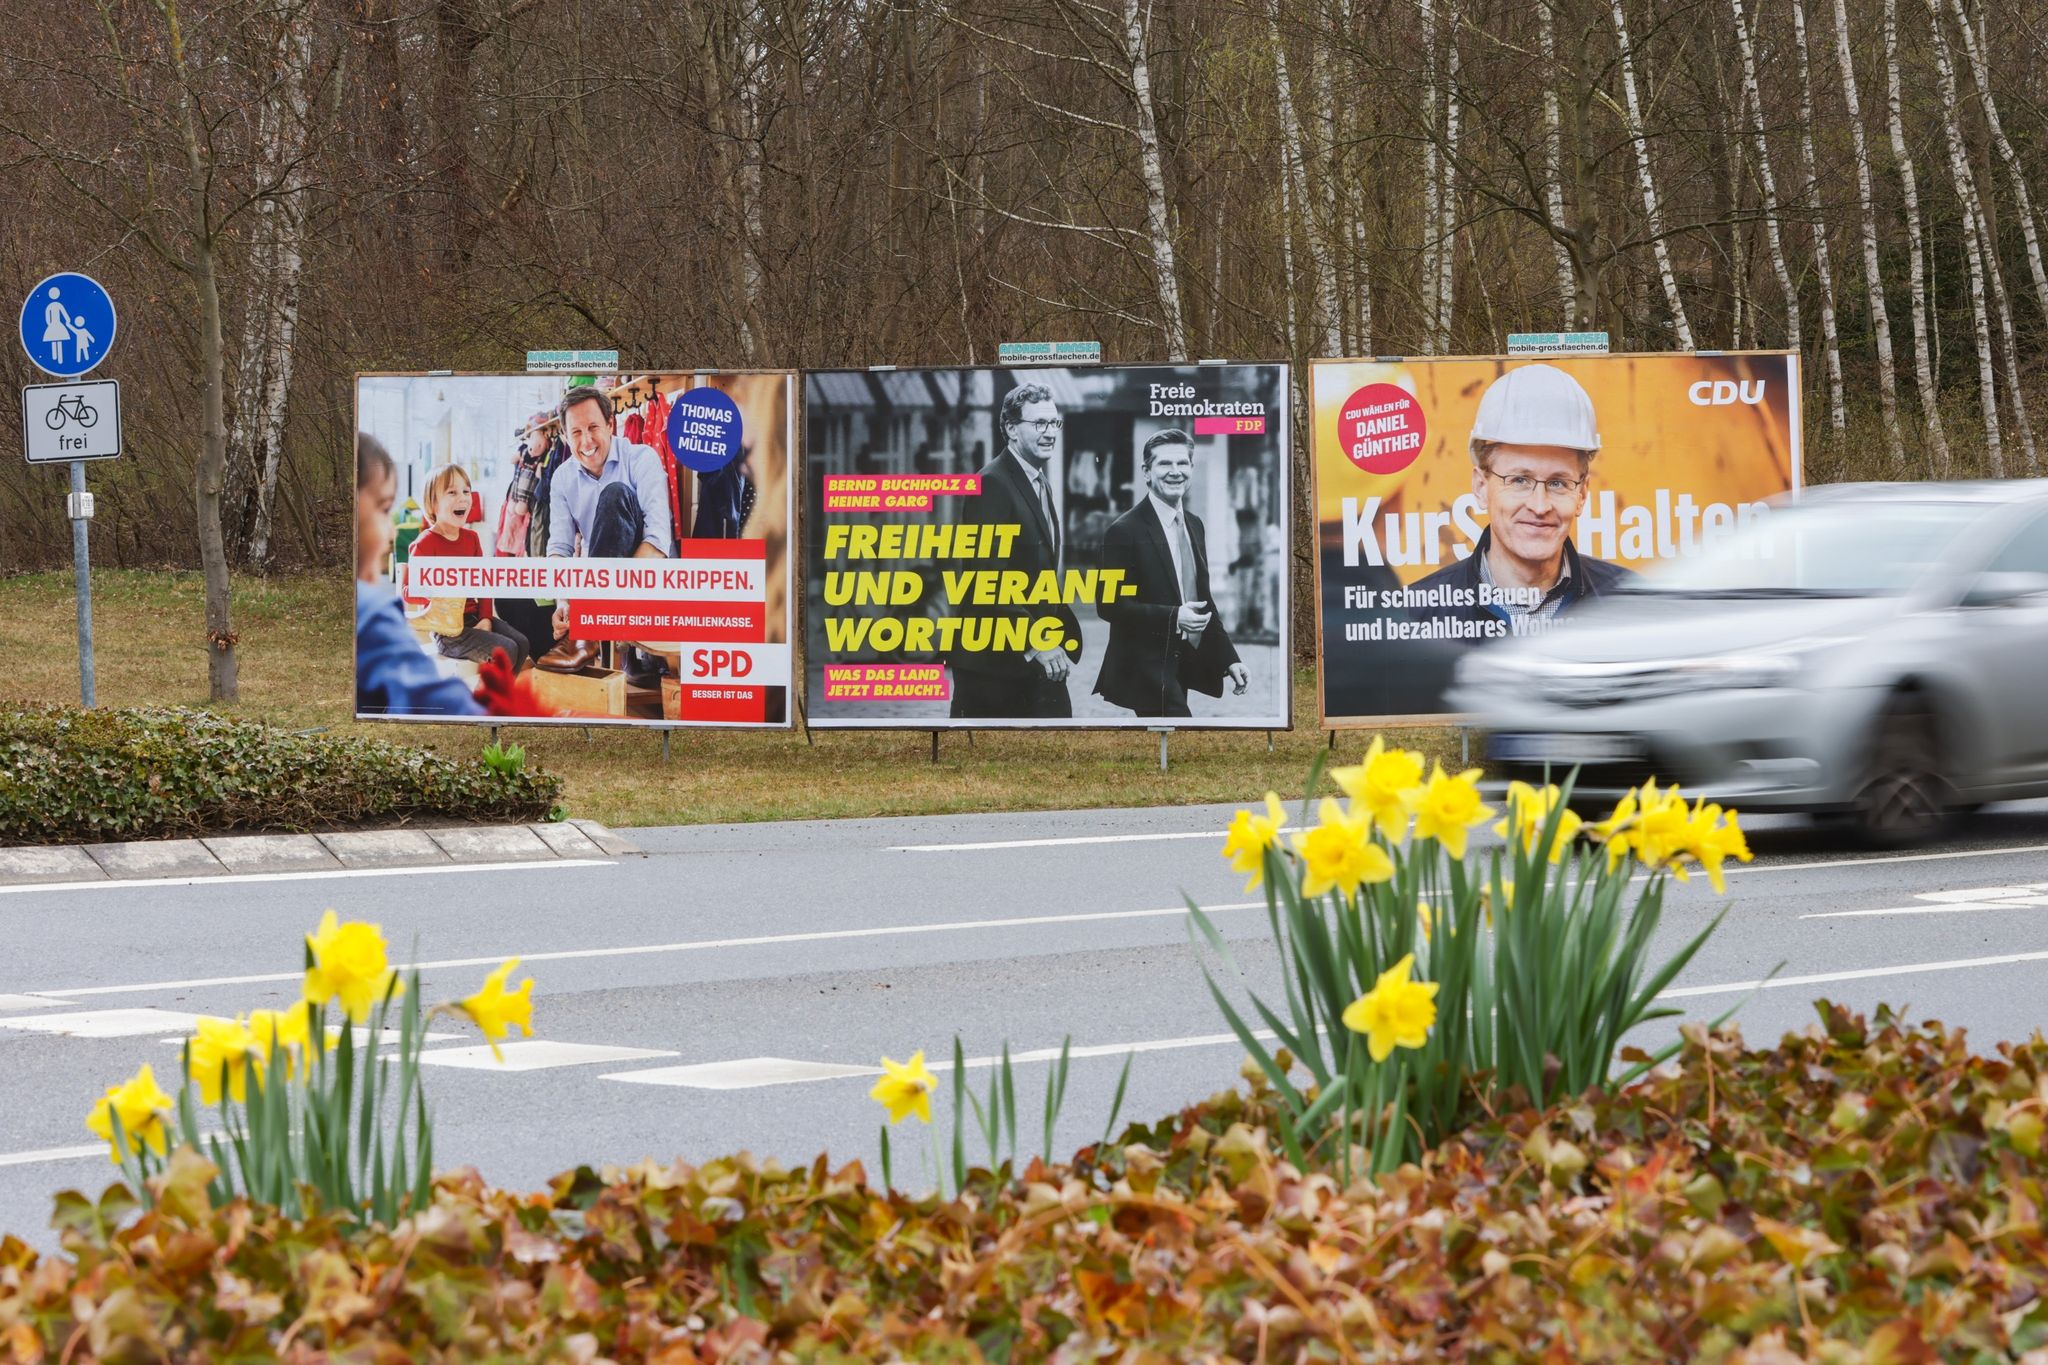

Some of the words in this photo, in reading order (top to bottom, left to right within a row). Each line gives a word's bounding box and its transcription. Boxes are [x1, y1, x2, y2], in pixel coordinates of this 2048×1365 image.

[1508, 343, 1608, 353] mobile-grossflaechen.de
[527, 361, 618, 369] mobile-grossflaechen.de
[1000, 353, 1100, 363] mobile-grossflaechen.de
[1150, 382, 1196, 399] Freie
[1688, 379, 1765, 405] CDU
[681, 403, 732, 423] THOMAS
[1150, 399, 1265, 416] Demokraten
[1345, 410, 1361, 420] CDU
[1362, 403, 1395, 417] WÄHLEN
[1395, 399, 1410, 411] FÜR
[683, 420, 726, 438] LOSSE-
[1236, 420, 1262, 431] FDP
[1356, 414, 1408, 438] DANIEL
[59, 433, 87, 450] frei
[678, 435, 727, 456] MÜLLER
[1353, 432, 1420, 459] GÜNTHER
[828, 480, 877, 491] BERND
[881, 479, 960, 491] BUCHHOLZ
[964, 479, 976, 490] &
[828, 496, 880, 508] HEINER
[885, 495, 928, 507] GARG
[824, 524, 1021, 559] FREIHEIT
[419, 567, 548, 588] KOSTENFREIE
[553, 569, 610, 588] KITAS
[615, 570, 656, 588] UND
[663, 570, 754, 590] KRIPPEN.
[824, 571, 923, 605] UND
[942, 569, 1137, 604] VERANT-
[1344, 586, 1377, 609] Für
[1381, 584, 1476, 608] schnelles
[1479, 584, 1542, 606] Bauen
[580, 615, 594, 625] DA
[596, 615, 626, 626] FREUT
[628, 615, 652, 626] SICH
[654, 616, 670, 626] DIE
[672, 616, 753, 628] FAMILIENKASSE.
[1345, 618, 1383, 641] und
[1387, 616, 1507, 640] bezahlbares
[824, 617, 1079, 653] WORTUNG.
[692, 649, 753, 678] SPD
[829, 669, 861, 681] WAS
[865, 669, 895, 680] DAS
[899, 669, 940, 681] LAND
[692, 690, 722, 699] BESSER
[723, 690, 735, 699] IST
[737, 690, 753, 699] DAS
[828, 685, 870, 696] JETZT
[874, 684, 945, 696] BRAUCHT.
